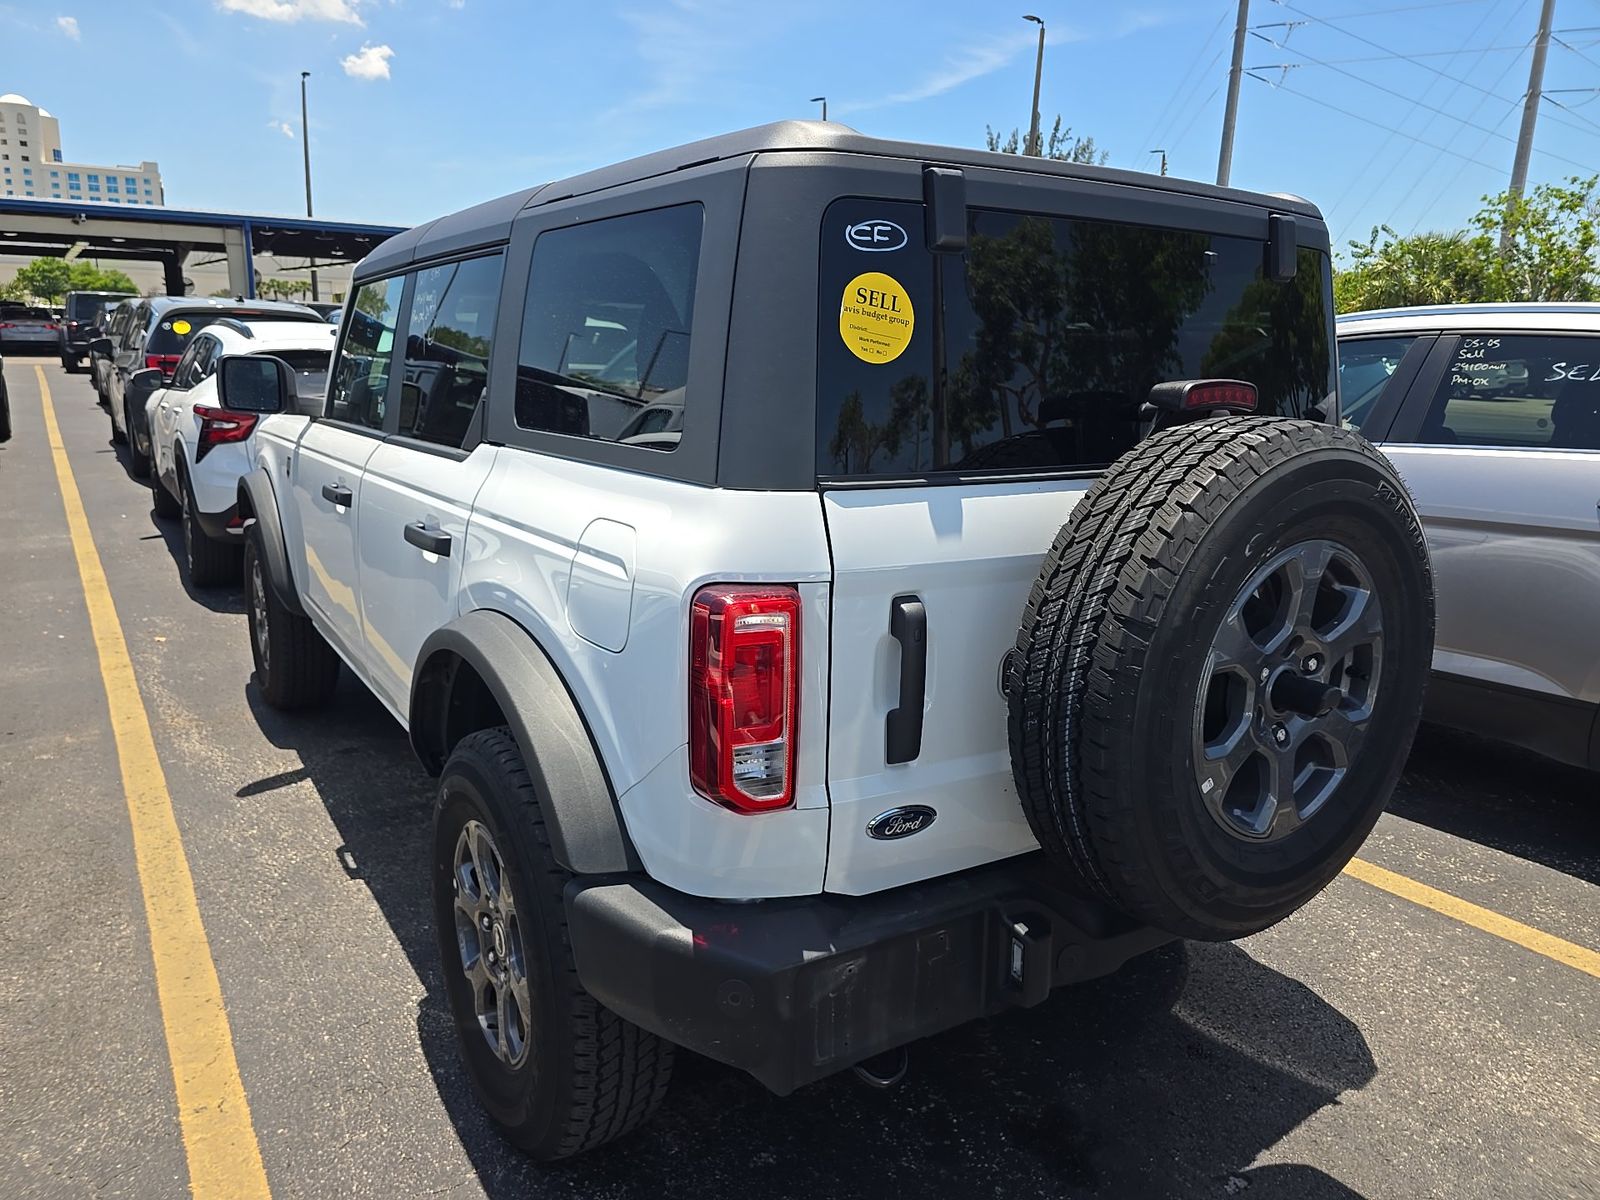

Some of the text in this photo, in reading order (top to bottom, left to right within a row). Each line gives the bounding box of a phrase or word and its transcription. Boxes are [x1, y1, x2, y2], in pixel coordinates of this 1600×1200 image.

[856, 287, 902, 313] SELL
[843, 304, 910, 328] avis budget group
[884, 813, 924, 835] Ford
